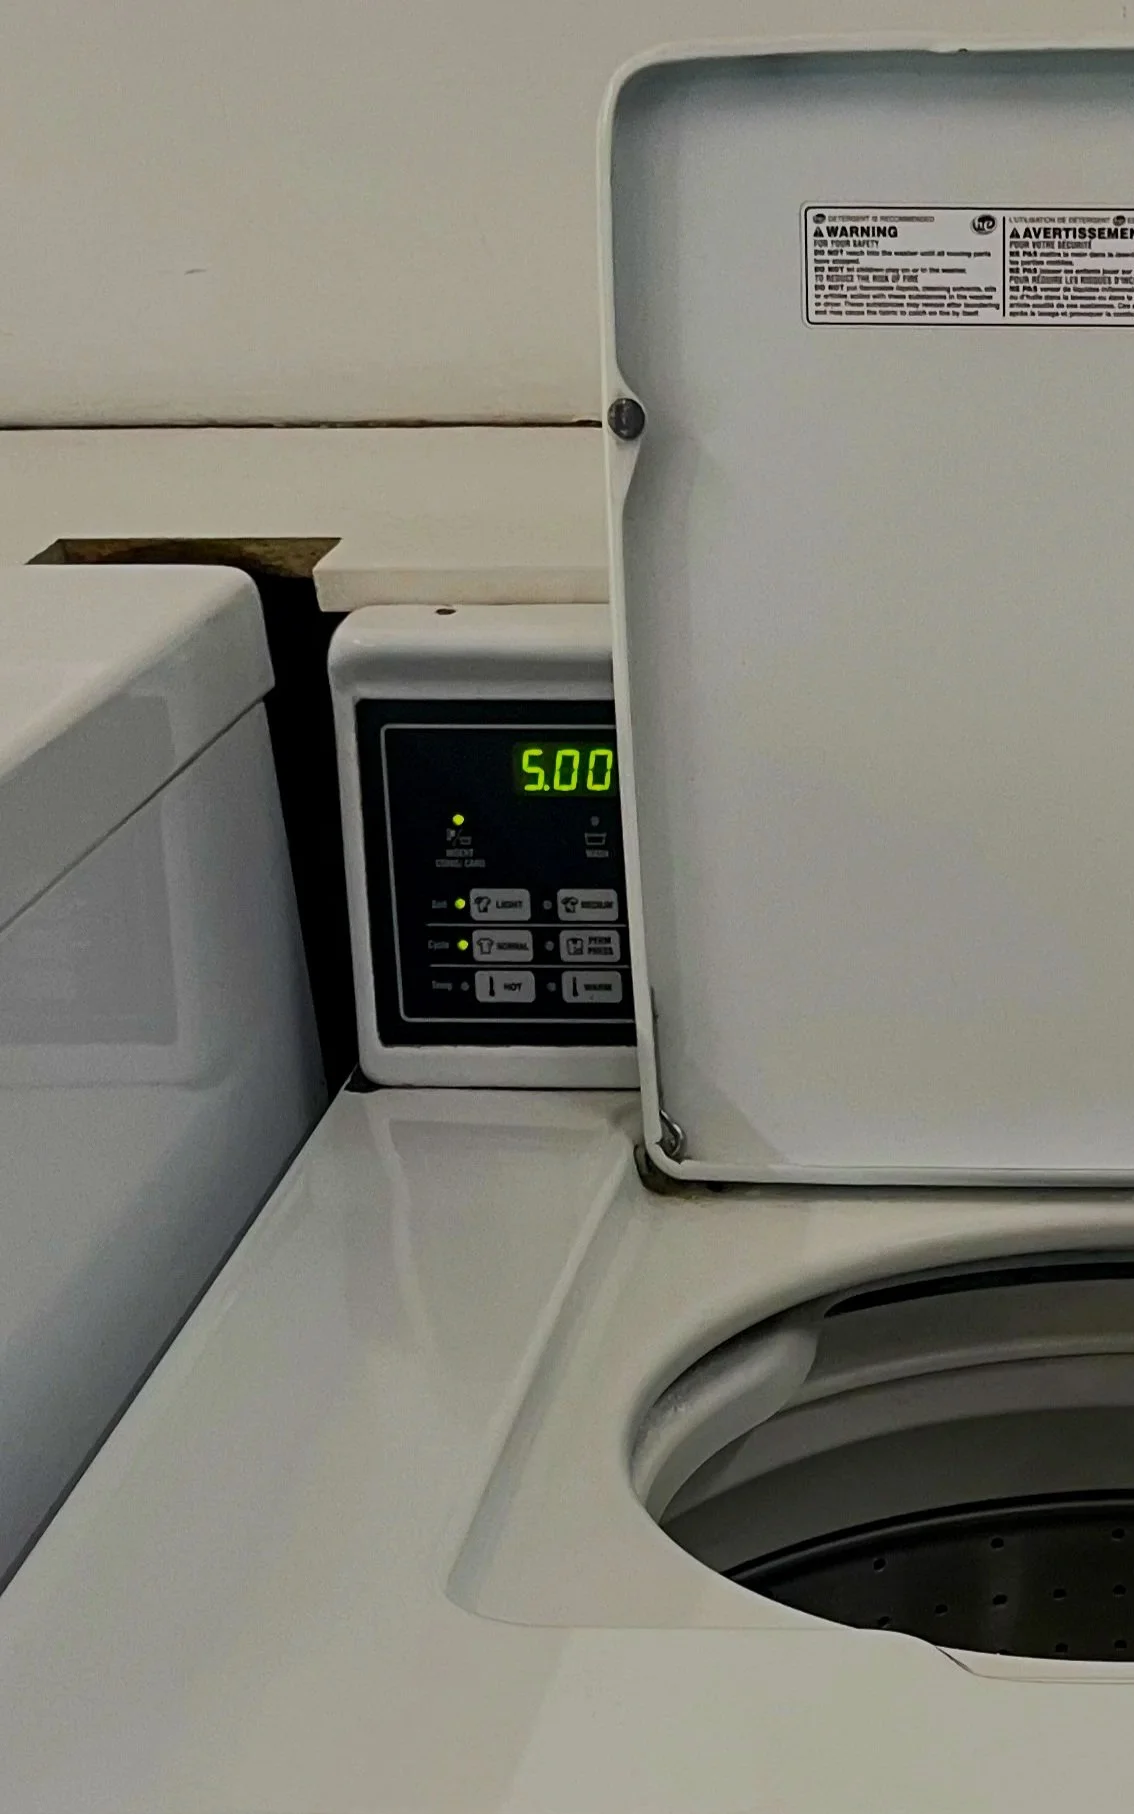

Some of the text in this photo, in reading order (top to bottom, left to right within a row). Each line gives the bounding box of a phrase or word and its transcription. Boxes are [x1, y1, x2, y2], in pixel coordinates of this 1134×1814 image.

[826, 225, 898, 238] WARNING
[813, 239, 879, 248] FOR YOUR SAFETY
[1009, 240, 1029, 249] POUR
[1032, 240, 1055, 249] VOTRE
[522, 748, 613, 792] 5.00
[495, 900, 523, 909] LIGHT
[588, 936, 612, 945] PERM
[496, 942, 529, 951] NORMAL
[503, 982, 522, 991] HOT
